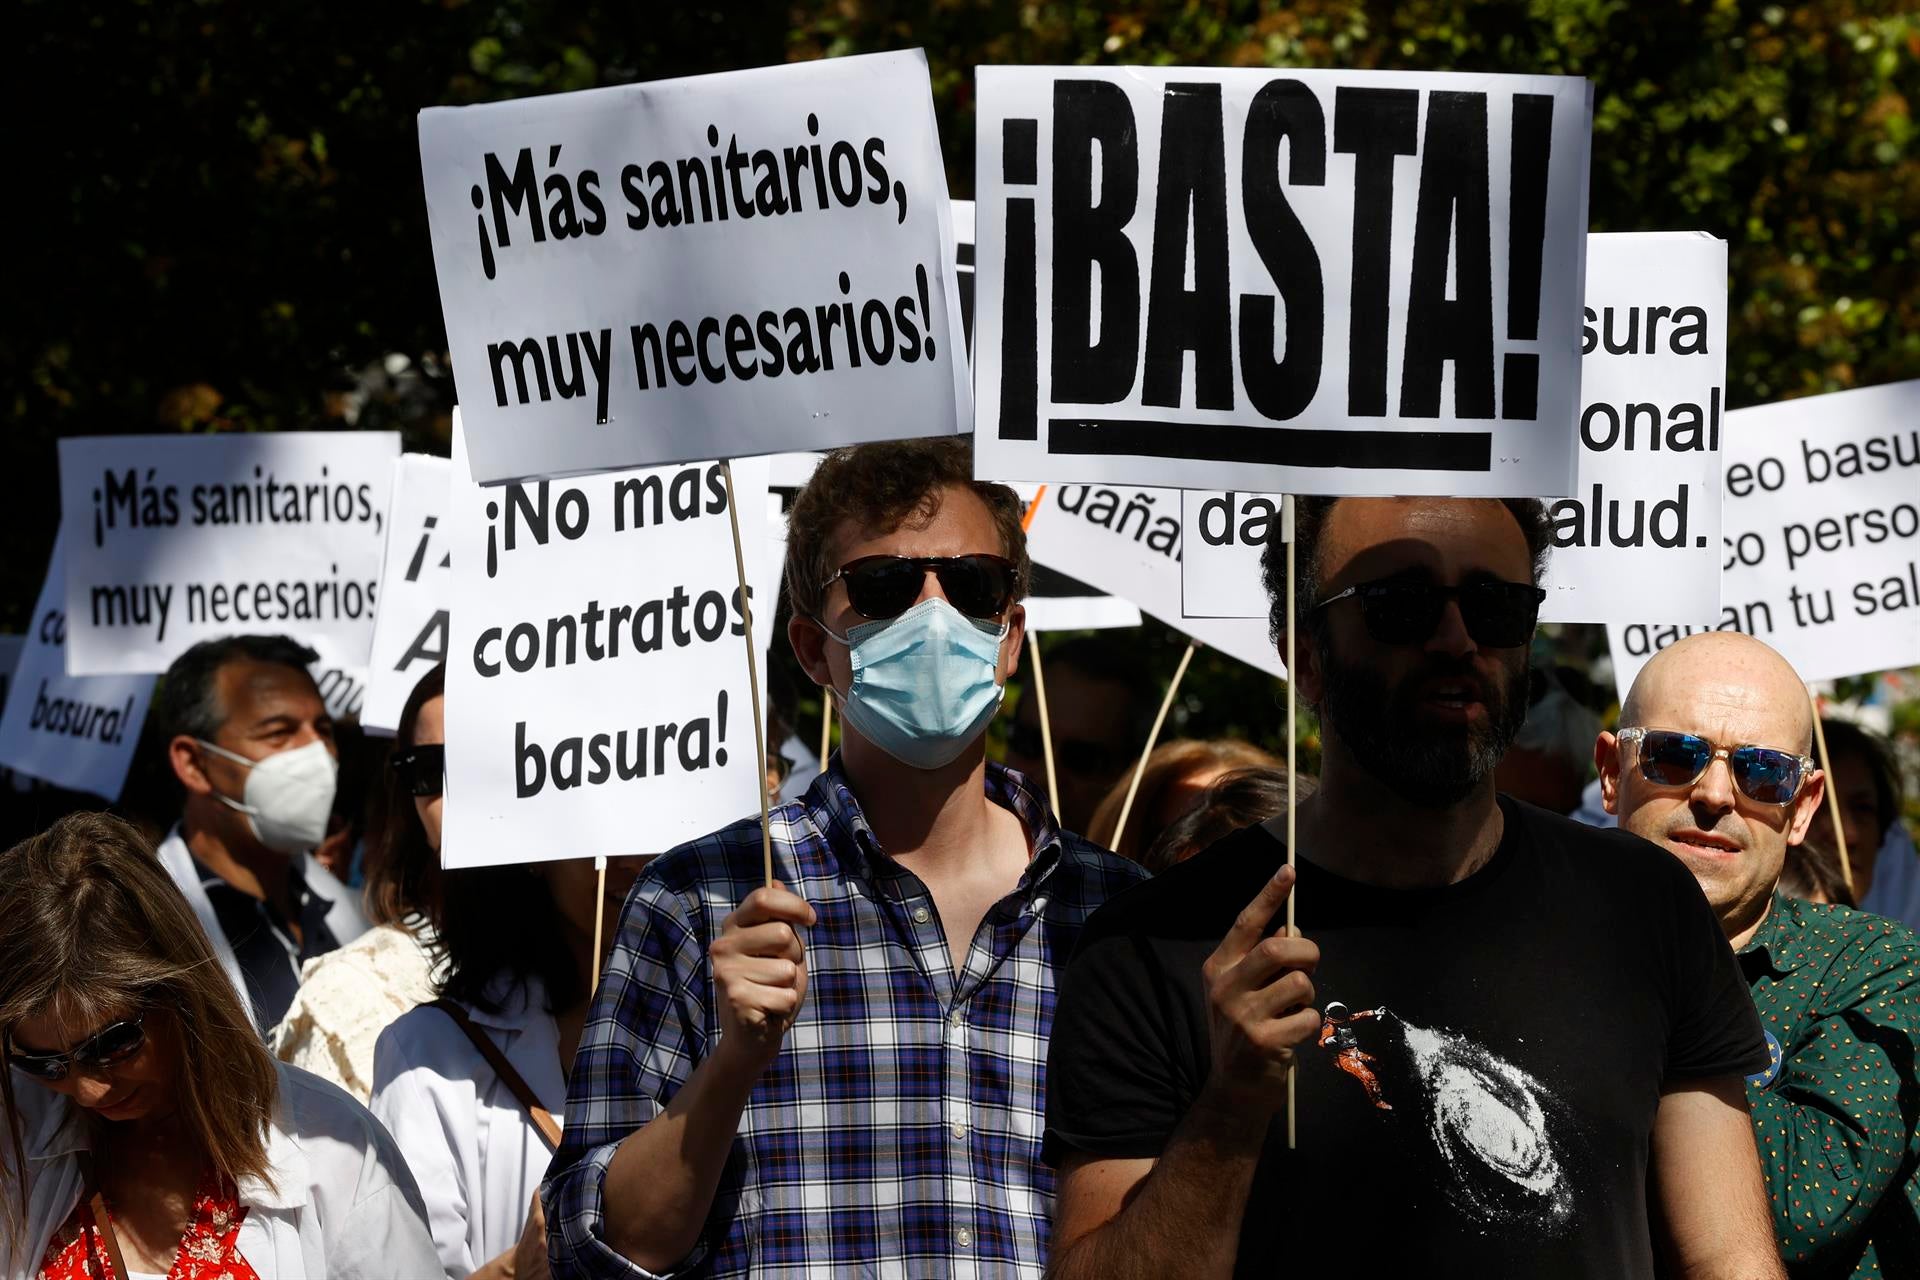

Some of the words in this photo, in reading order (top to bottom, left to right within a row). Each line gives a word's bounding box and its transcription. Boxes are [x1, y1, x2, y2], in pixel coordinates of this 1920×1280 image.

[471, 144, 607, 280] ¡Más
[620, 113, 907, 231] sanitarios,
[998, 78, 1555, 441] ¡BASTA!
[487, 328, 612, 425] muy
[630, 263, 936, 390] necesarios!
[1582, 306, 1709, 356] sura
[1580, 386, 1721, 452] onal
[1801, 430, 1920, 484] basu
[92, 468, 180, 548] ¡Más
[191, 465, 383, 538] sanitarios,
[486, 480, 590, 578] ¡No
[1555, 483, 1708, 548] alud.
[1783, 502, 1920, 571] perso
[90, 583, 173, 642] muy
[1790, 584, 1834, 629] tu
[1853, 562, 1920, 617] sal
[473, 585, 753, 678] contratos
[30, 677, 134, 746] basura!
[516, 689, 729, 799] basura!
